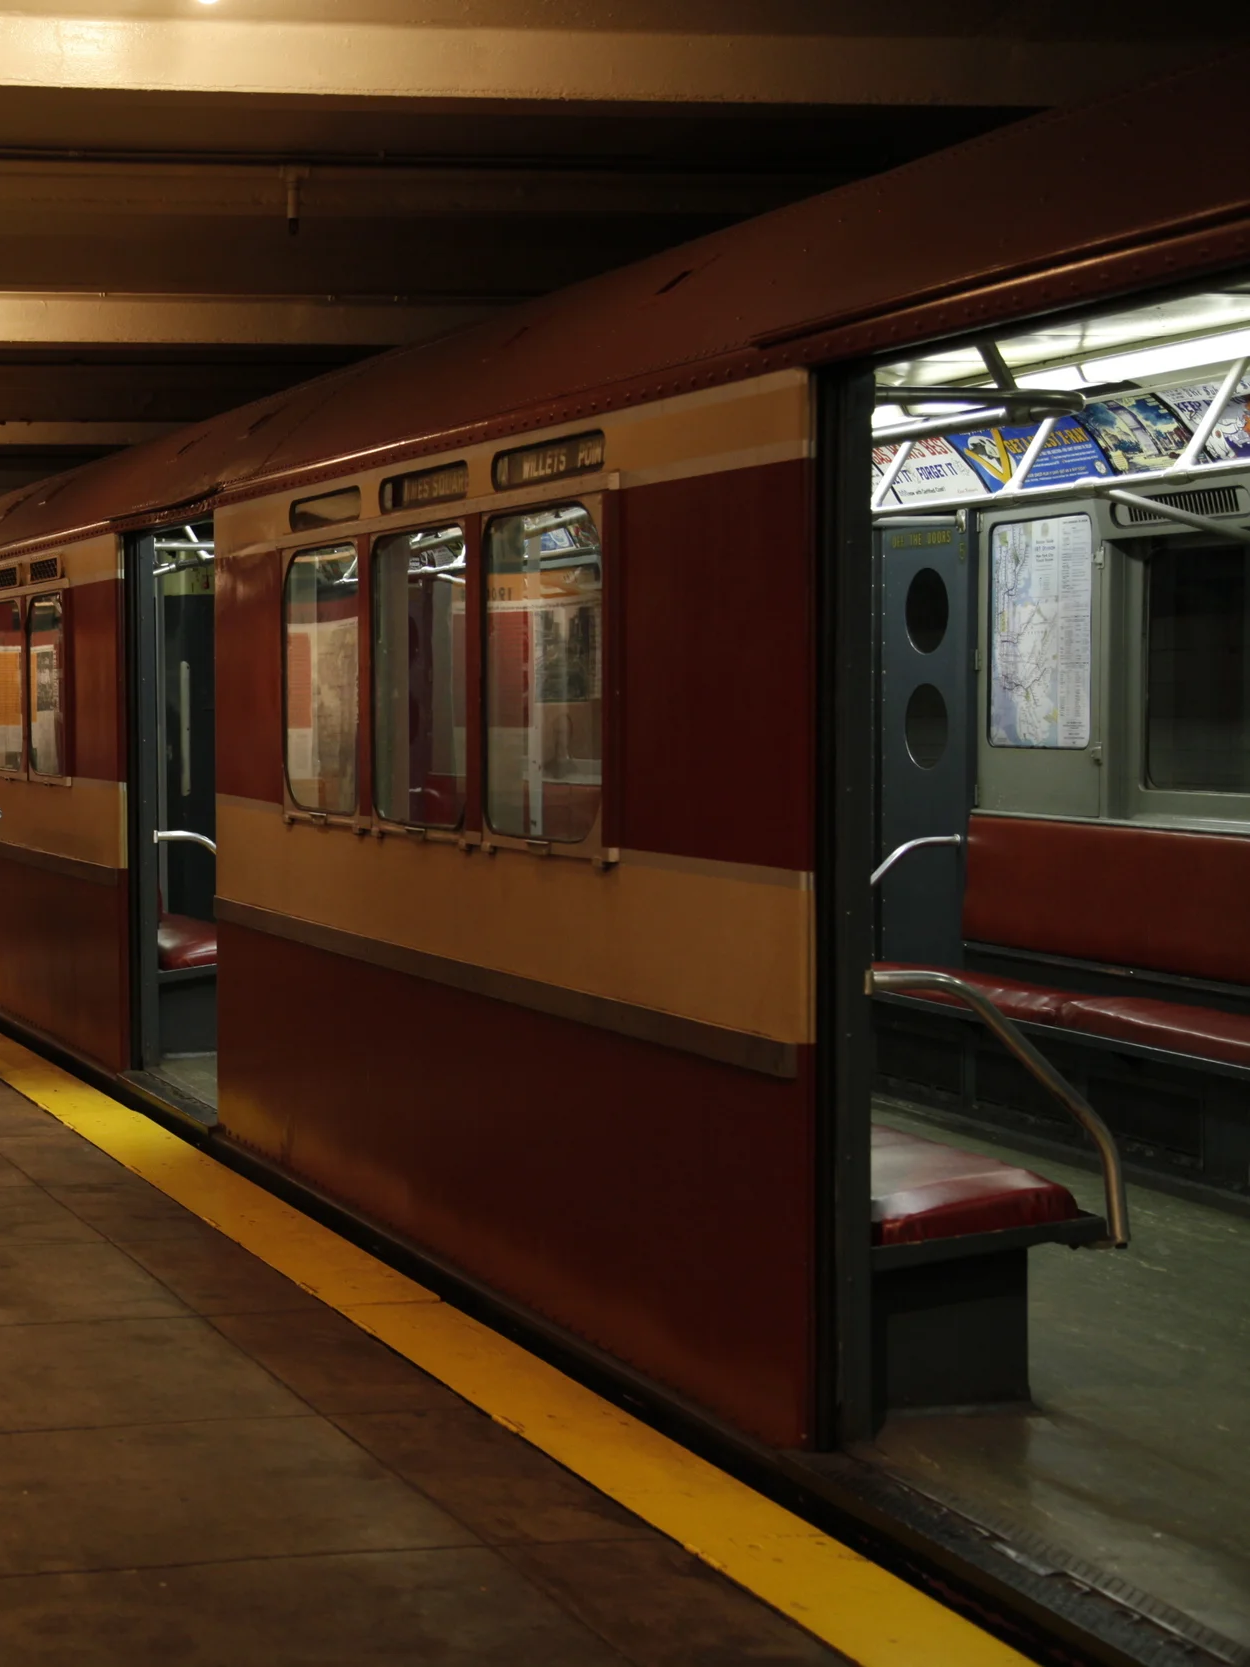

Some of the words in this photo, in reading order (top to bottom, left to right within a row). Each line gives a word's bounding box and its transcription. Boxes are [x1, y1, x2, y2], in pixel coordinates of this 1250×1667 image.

[917, 436, 952, 456] BEST
[522, 447, 567, 480] WILLETS
[915, 464, 948, 481] FORGET
[945, 462, 958, 477] IT
[927, 530, 951, 544] DOORS
